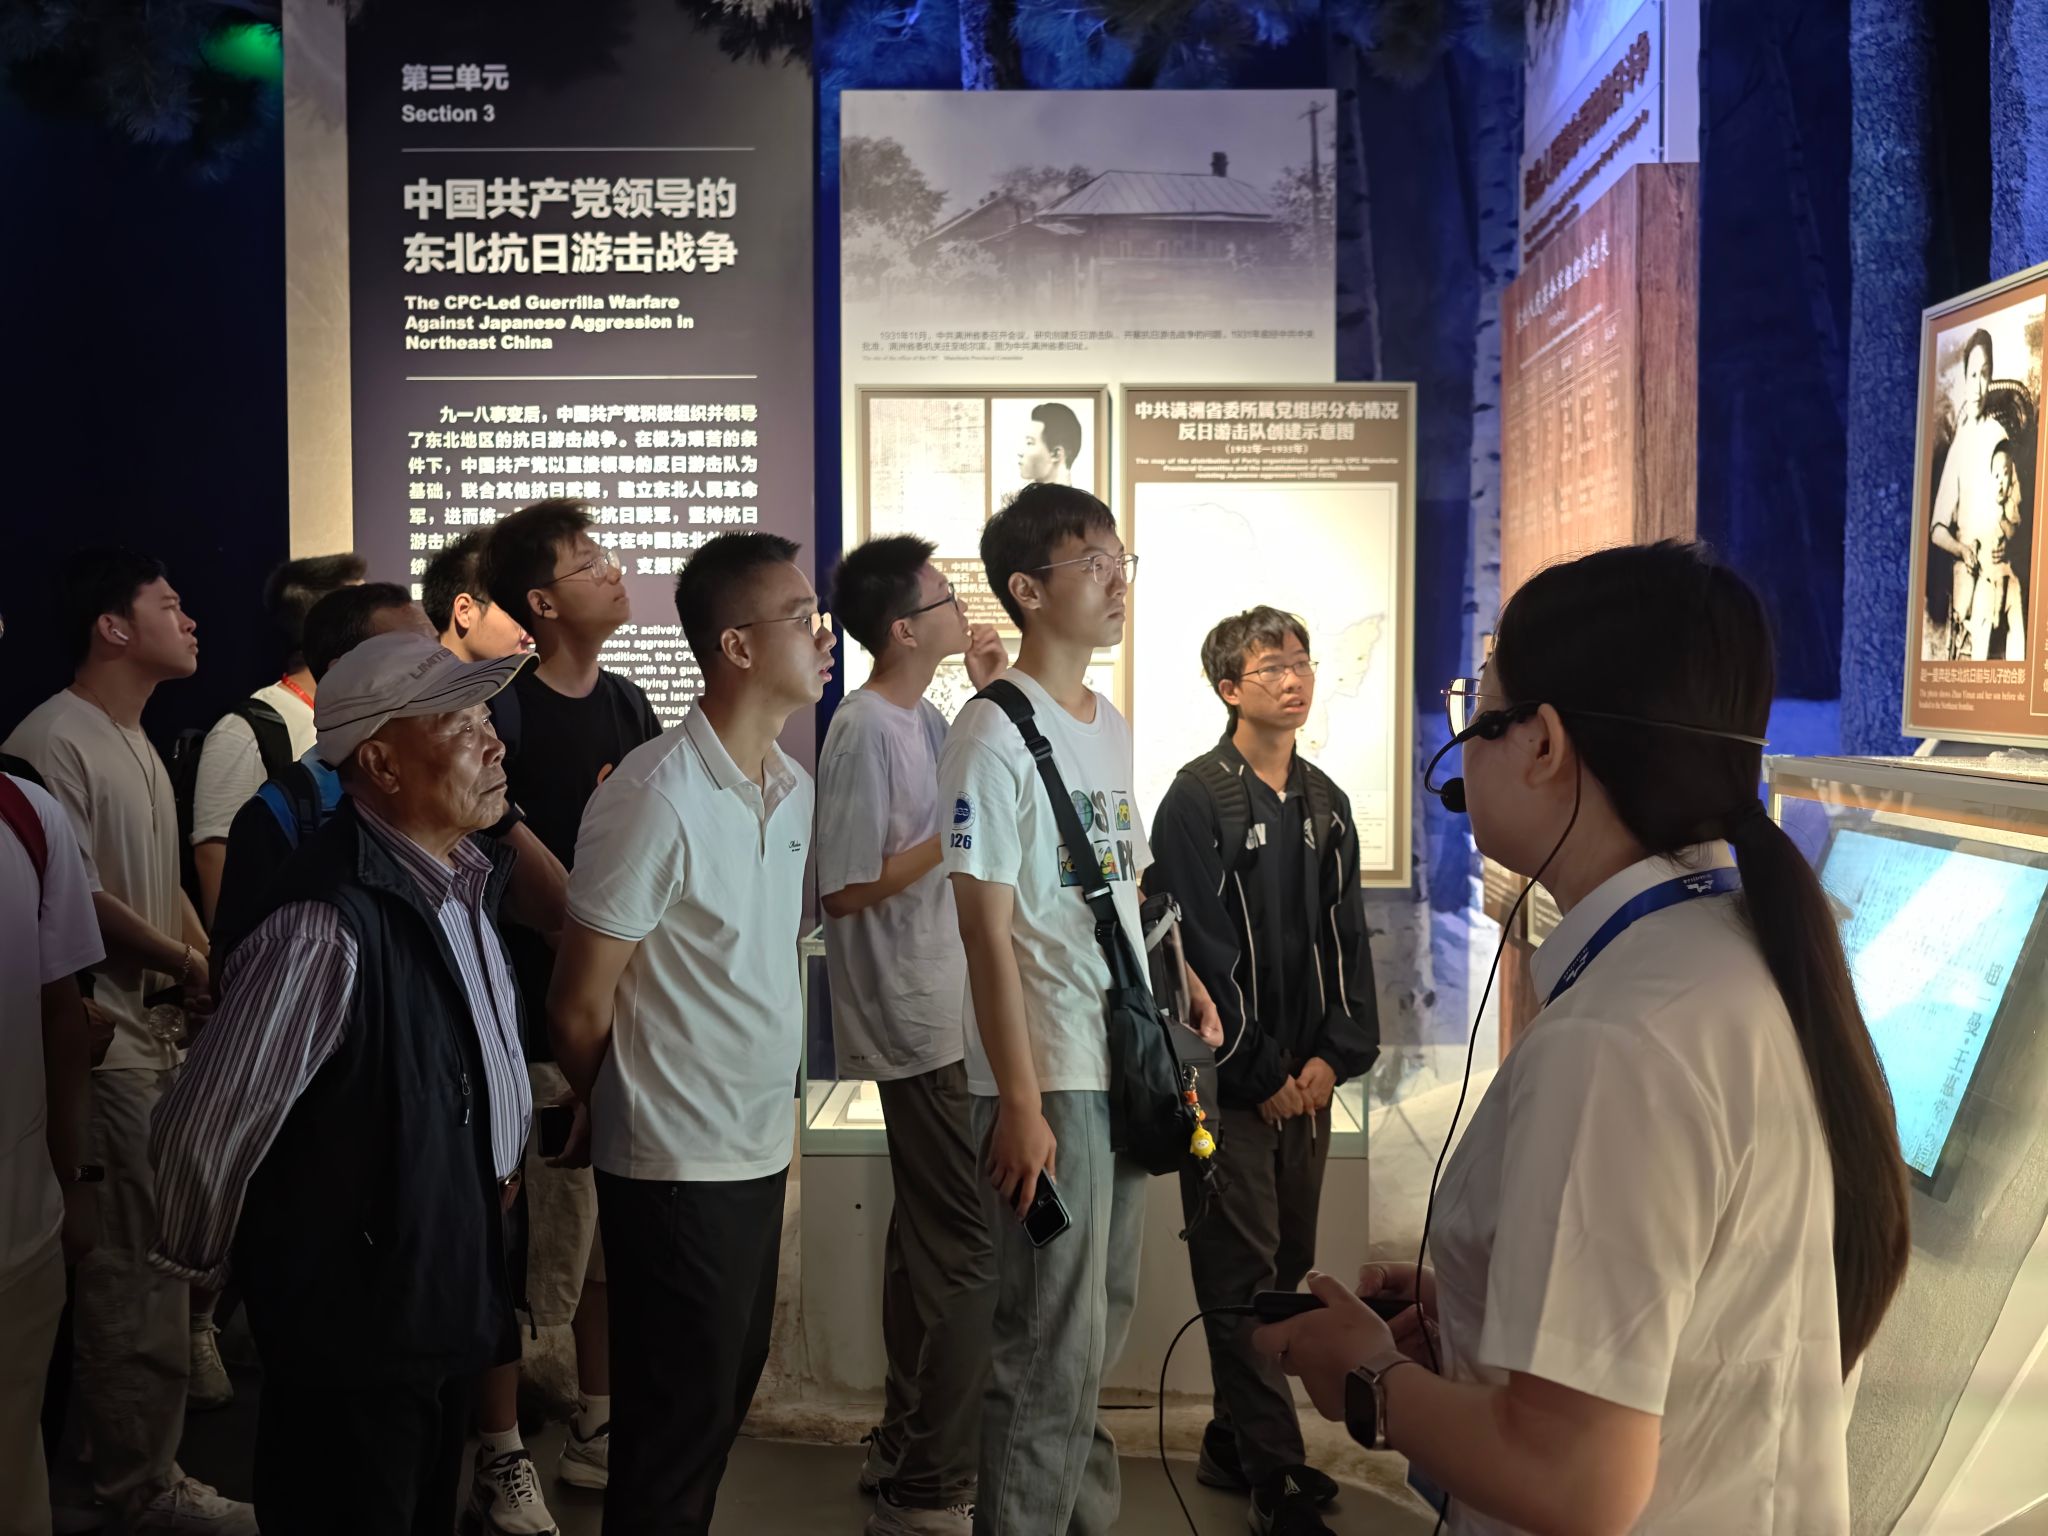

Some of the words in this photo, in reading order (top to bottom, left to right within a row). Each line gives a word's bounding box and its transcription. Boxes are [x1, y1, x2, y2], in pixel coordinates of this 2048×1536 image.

[402, 64, 509, 91] 第三单元
[402, 105, 478, 122] Section
[484, 105, 496, 122] 3
[404, 177, 737, 219] 中国共产党领导的
[403, 231, 738, 274] 东北抗日游击战争
[404, 296, 440, 310] The
[444, 295, 521, 310] CPC-Led
[526, 295, 604, 310] Guerrilla
[608, 294, 680, 309] Warfare
[405, 315, 474, 333] Against
[478, 315, 566, 333] Japanese
[570, 314, 673, 332] Aggression
[405, 335, 496, 350] Northeast
[500, 335, 553, 350] China
[1135, 401, 1398, 420] 中共满洲省委所属党组织分布情况
[1178, 422, 1355, 441] 反日游击队创建示意图
[655, 651, 672, 662] the
[635, 665, 657, 675] with
[660, 665, 677, 675] the
[672, 678, 695, 688] with
[670, 692, 695, 702] later
